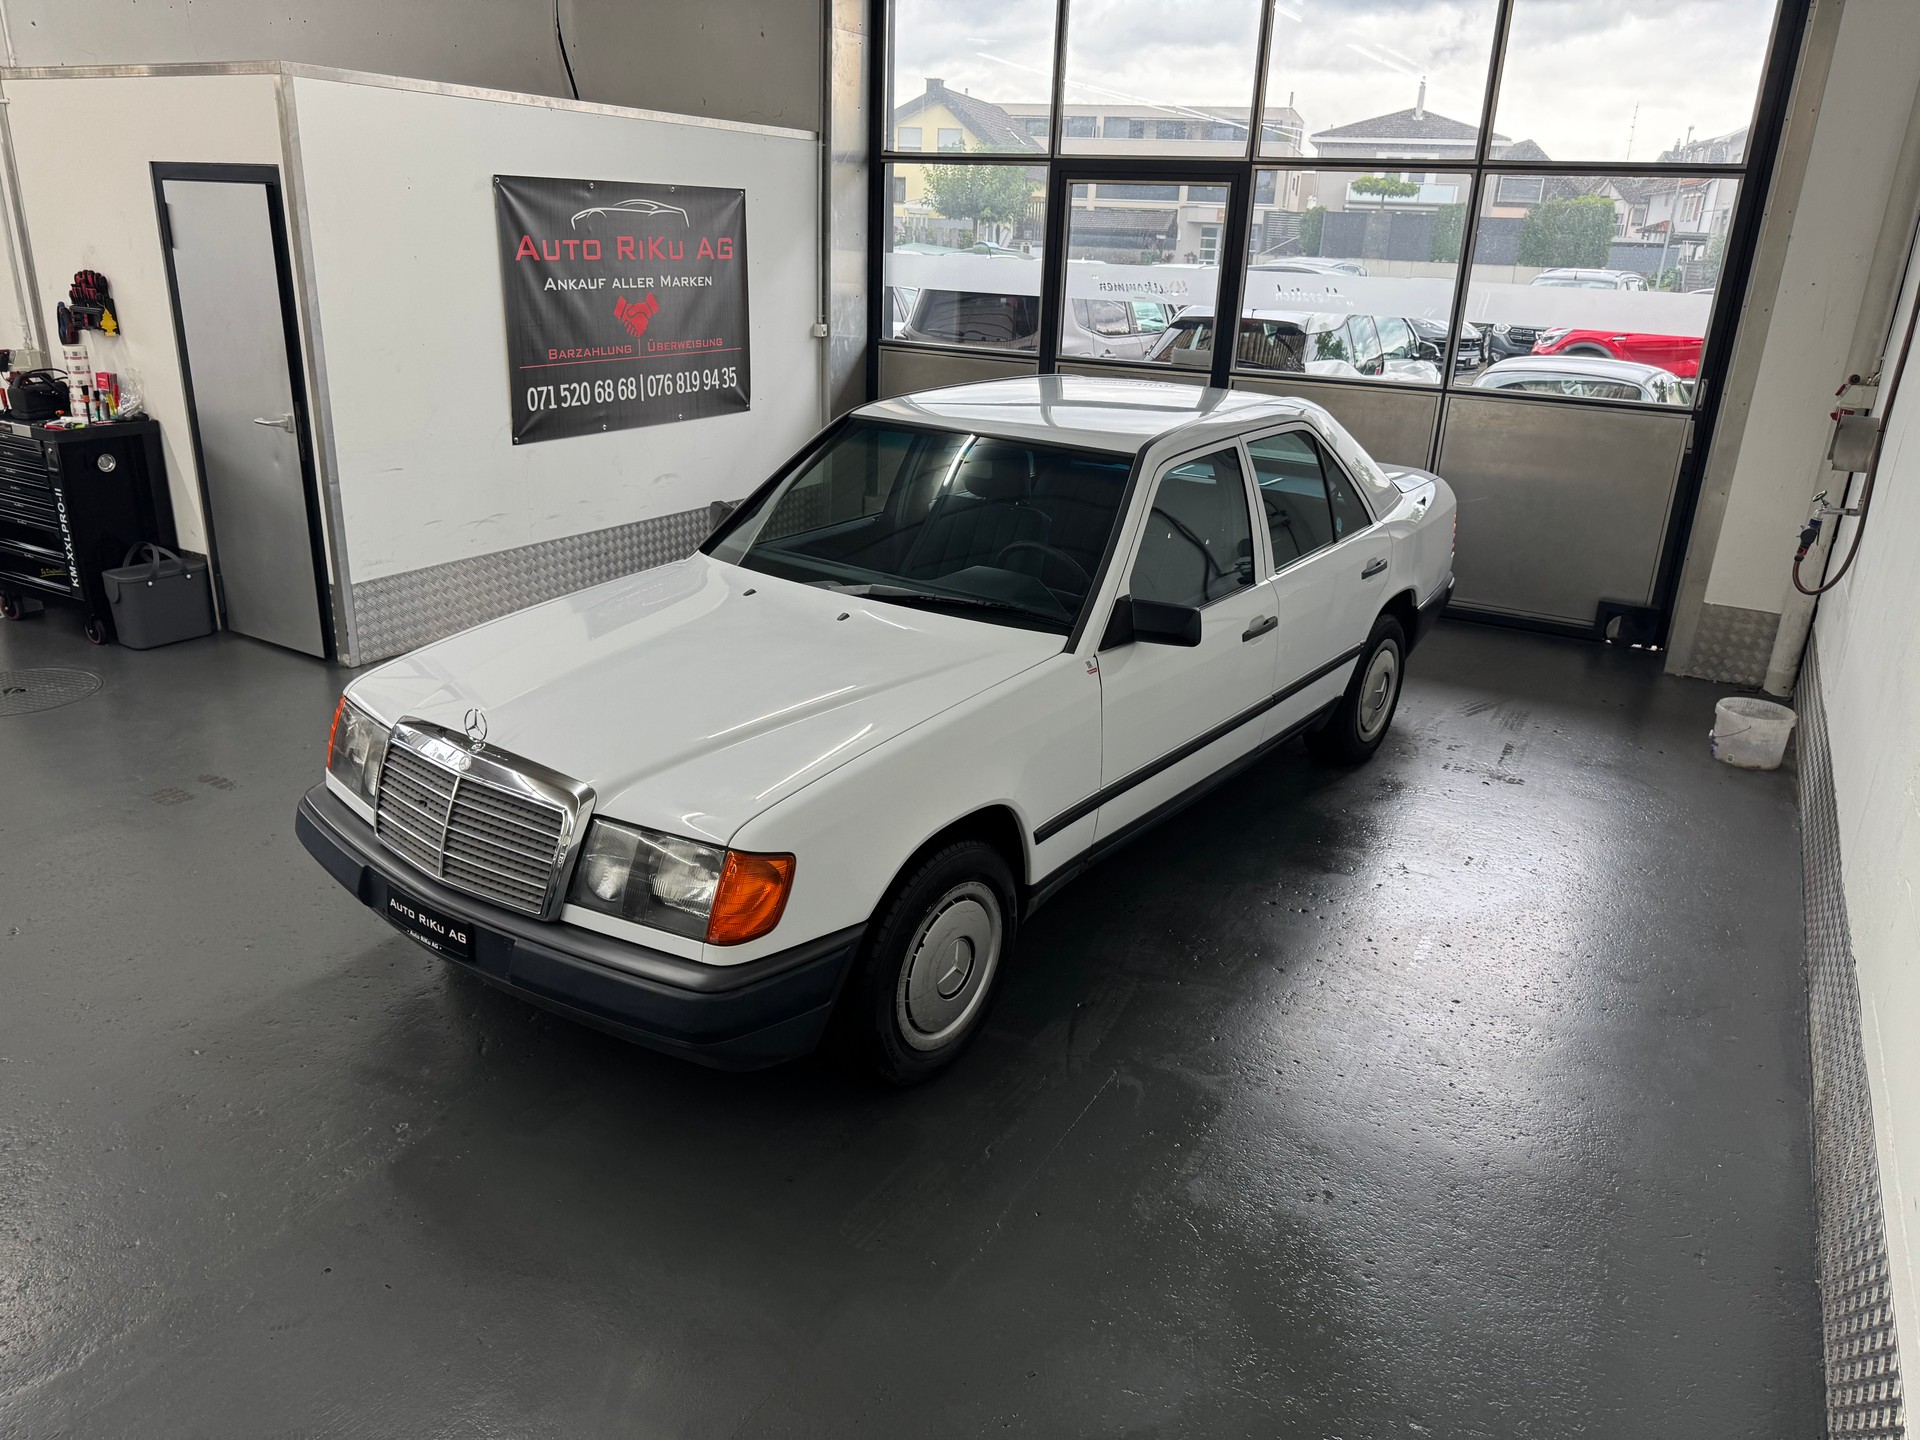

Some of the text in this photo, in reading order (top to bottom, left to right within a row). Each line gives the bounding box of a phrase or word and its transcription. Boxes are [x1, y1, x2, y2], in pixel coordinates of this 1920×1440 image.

[515, 235, 602, 261] AUTO
[696, 236, 734, 260] AG
[543, 274, 713, 291] ANKAUF ALLER MARKEN
[548, 337, 724, 360] BARZAHLUNG ÜBERWEISUNG
[526, 366, 738, 412] 071 520 68 68 076 819 94 35
[54, 487, 80, 588] KM-XXLPRO-II
[390, 898, 415, 919] AUTO
[448, 929, 467, 945] AG
